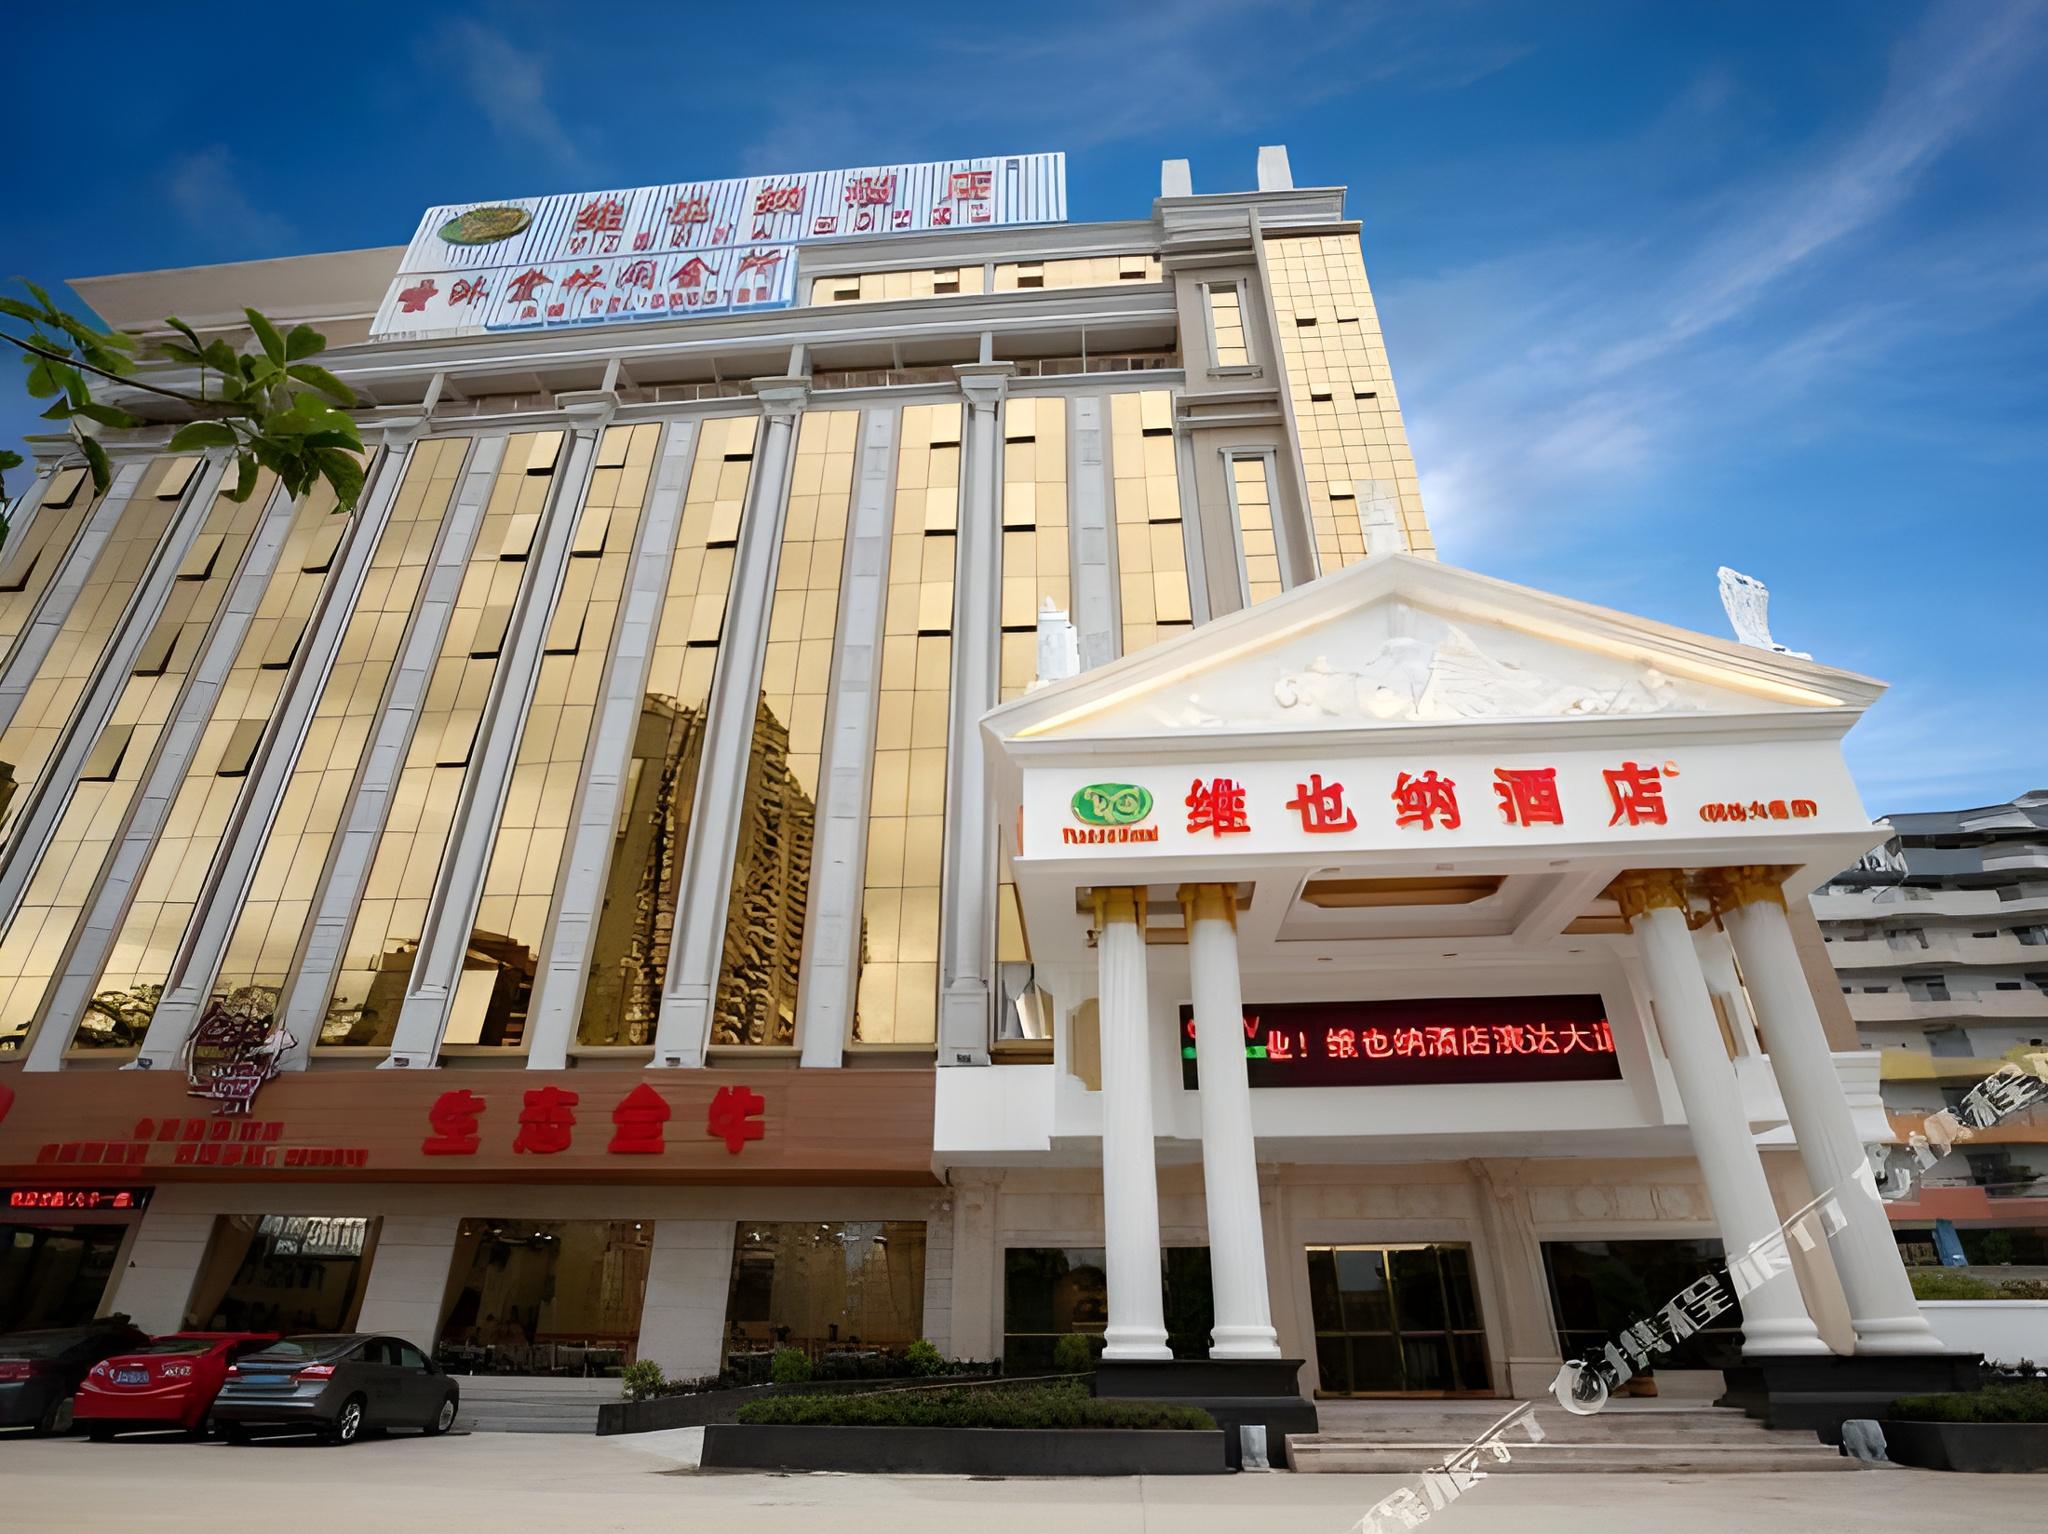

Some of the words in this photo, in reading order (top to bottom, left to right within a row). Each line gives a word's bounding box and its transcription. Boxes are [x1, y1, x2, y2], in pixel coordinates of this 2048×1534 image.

[1185, 761, 1668, 839] 维也纳酒店
